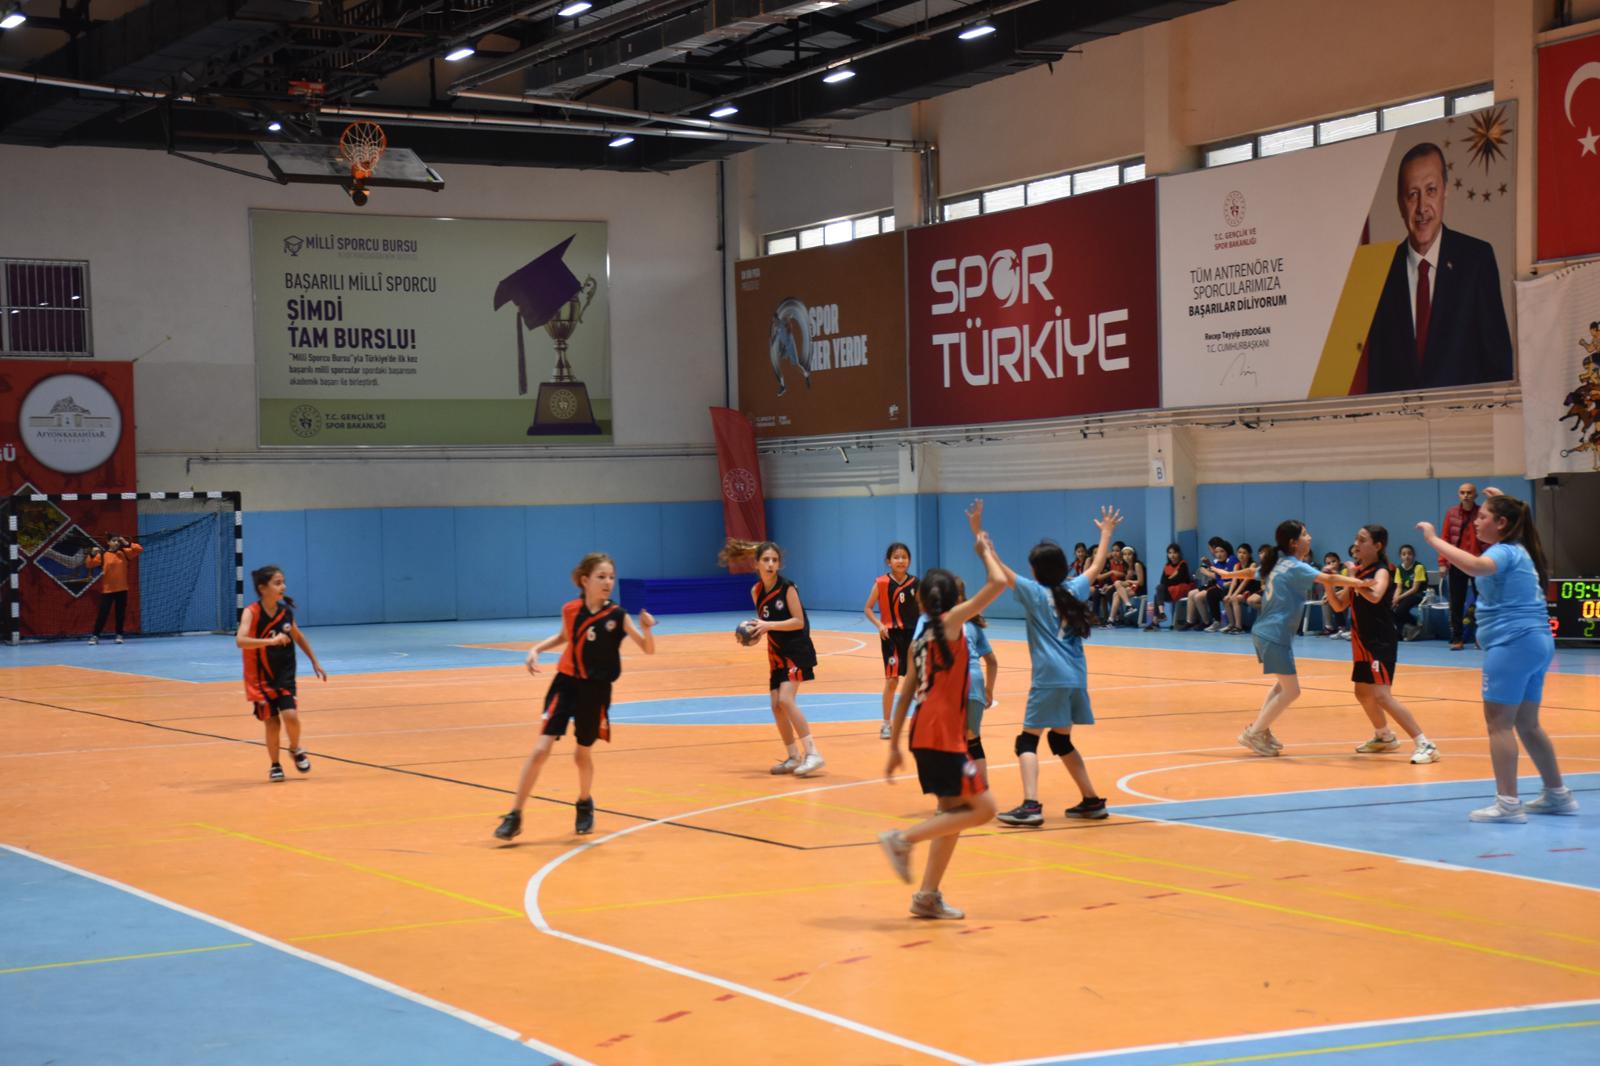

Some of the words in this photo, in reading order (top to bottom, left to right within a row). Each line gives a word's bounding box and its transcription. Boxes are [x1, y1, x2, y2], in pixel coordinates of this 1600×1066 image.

[1249, 227, 1257, 235] VE
[305, 234, 334, 249] MİLLÎ
[337, 237, 379, 251] SPORCU
[382, 239, 418, 252] BURSU
[285, 272, 344, 293] BAŞARILI
[349, 271, 383, 292] MİLLÎ
[386, 275, 437, 293] SPORCU
[931, 242, 1055, 315] SPOR
[1190, 267, 1212, 284] TÜM
[1214, 258, 1269, 280] ANTRENÖR
[1270, 258, 1284, 272] VE
[1193, 276, 1282, 300] SPORCULARIMIZA
[286, 294, 343, 326] ŞİMDİ
[1188, 301, 1236, 318] BAŞARILAR
[1237, 295, 1287, 311] DİLİYORUM
[808, 303, 840, 338] SPOR
[287, 326, 329, 348] TAM
[334, 327, 417, 350] BURSLU!
[1204, 332, 1222, 341] Recep
[1221, 330, 1241, 340] Tayyip
[1241, 326, 1271, 337] ERDOĞAN
[832, 334, 869, 369] YERDE
[932, 305, 1130, 388] TÜRKİYE
[1217, 339, 1270, 352] CUMHURBAŞKANI
[325, 422, 345, 430] SPOR
[340, 412, 374, 422] GENÇLİK
[376, 413, 385, 421] VE
[762, 605, 770, 618] 5
[586, 626, 596, 642] 6
